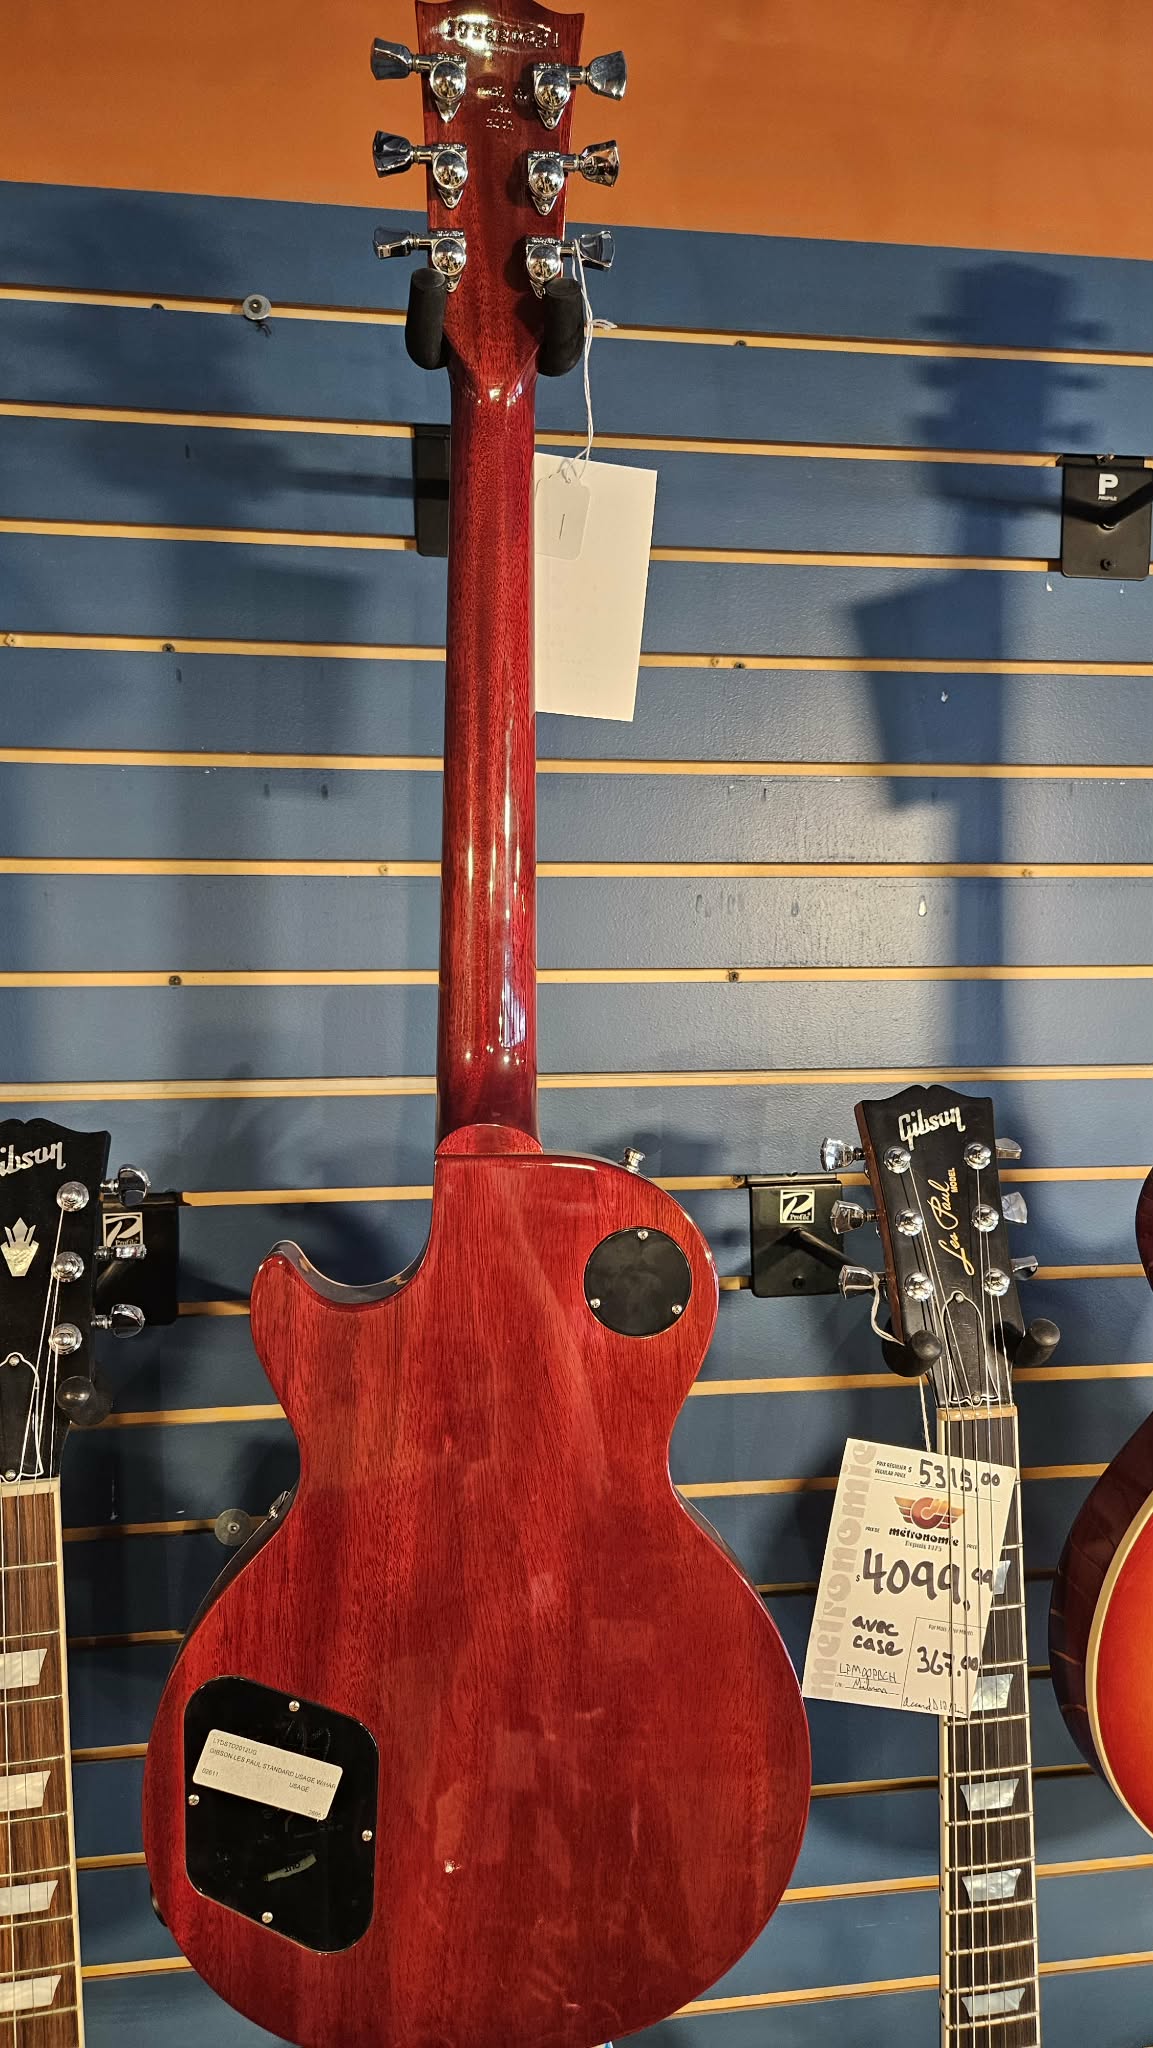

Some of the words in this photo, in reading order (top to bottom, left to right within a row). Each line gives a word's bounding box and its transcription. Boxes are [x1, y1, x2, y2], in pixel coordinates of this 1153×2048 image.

[898, 1106, 966, 1151] Gibson
[0, 1142, 66, 1176] ibson
[947, 1167, 959, 1193] MODEL
[927, 1179, 959, 1230] Paul
[938, 1232, 975, 1276] Les
[851, 1615, 900, 1637] avec
[852, 1634, 904, 1657] case
[233, 1754, 246, 1763] LES
[245, 1758, 262, 1768] PAUL
[262, 1763, 295, 1777] STANDARD
[294, 1772, 316, 1784] USAGE
[288, 1781, 310, 1793] USAGE
